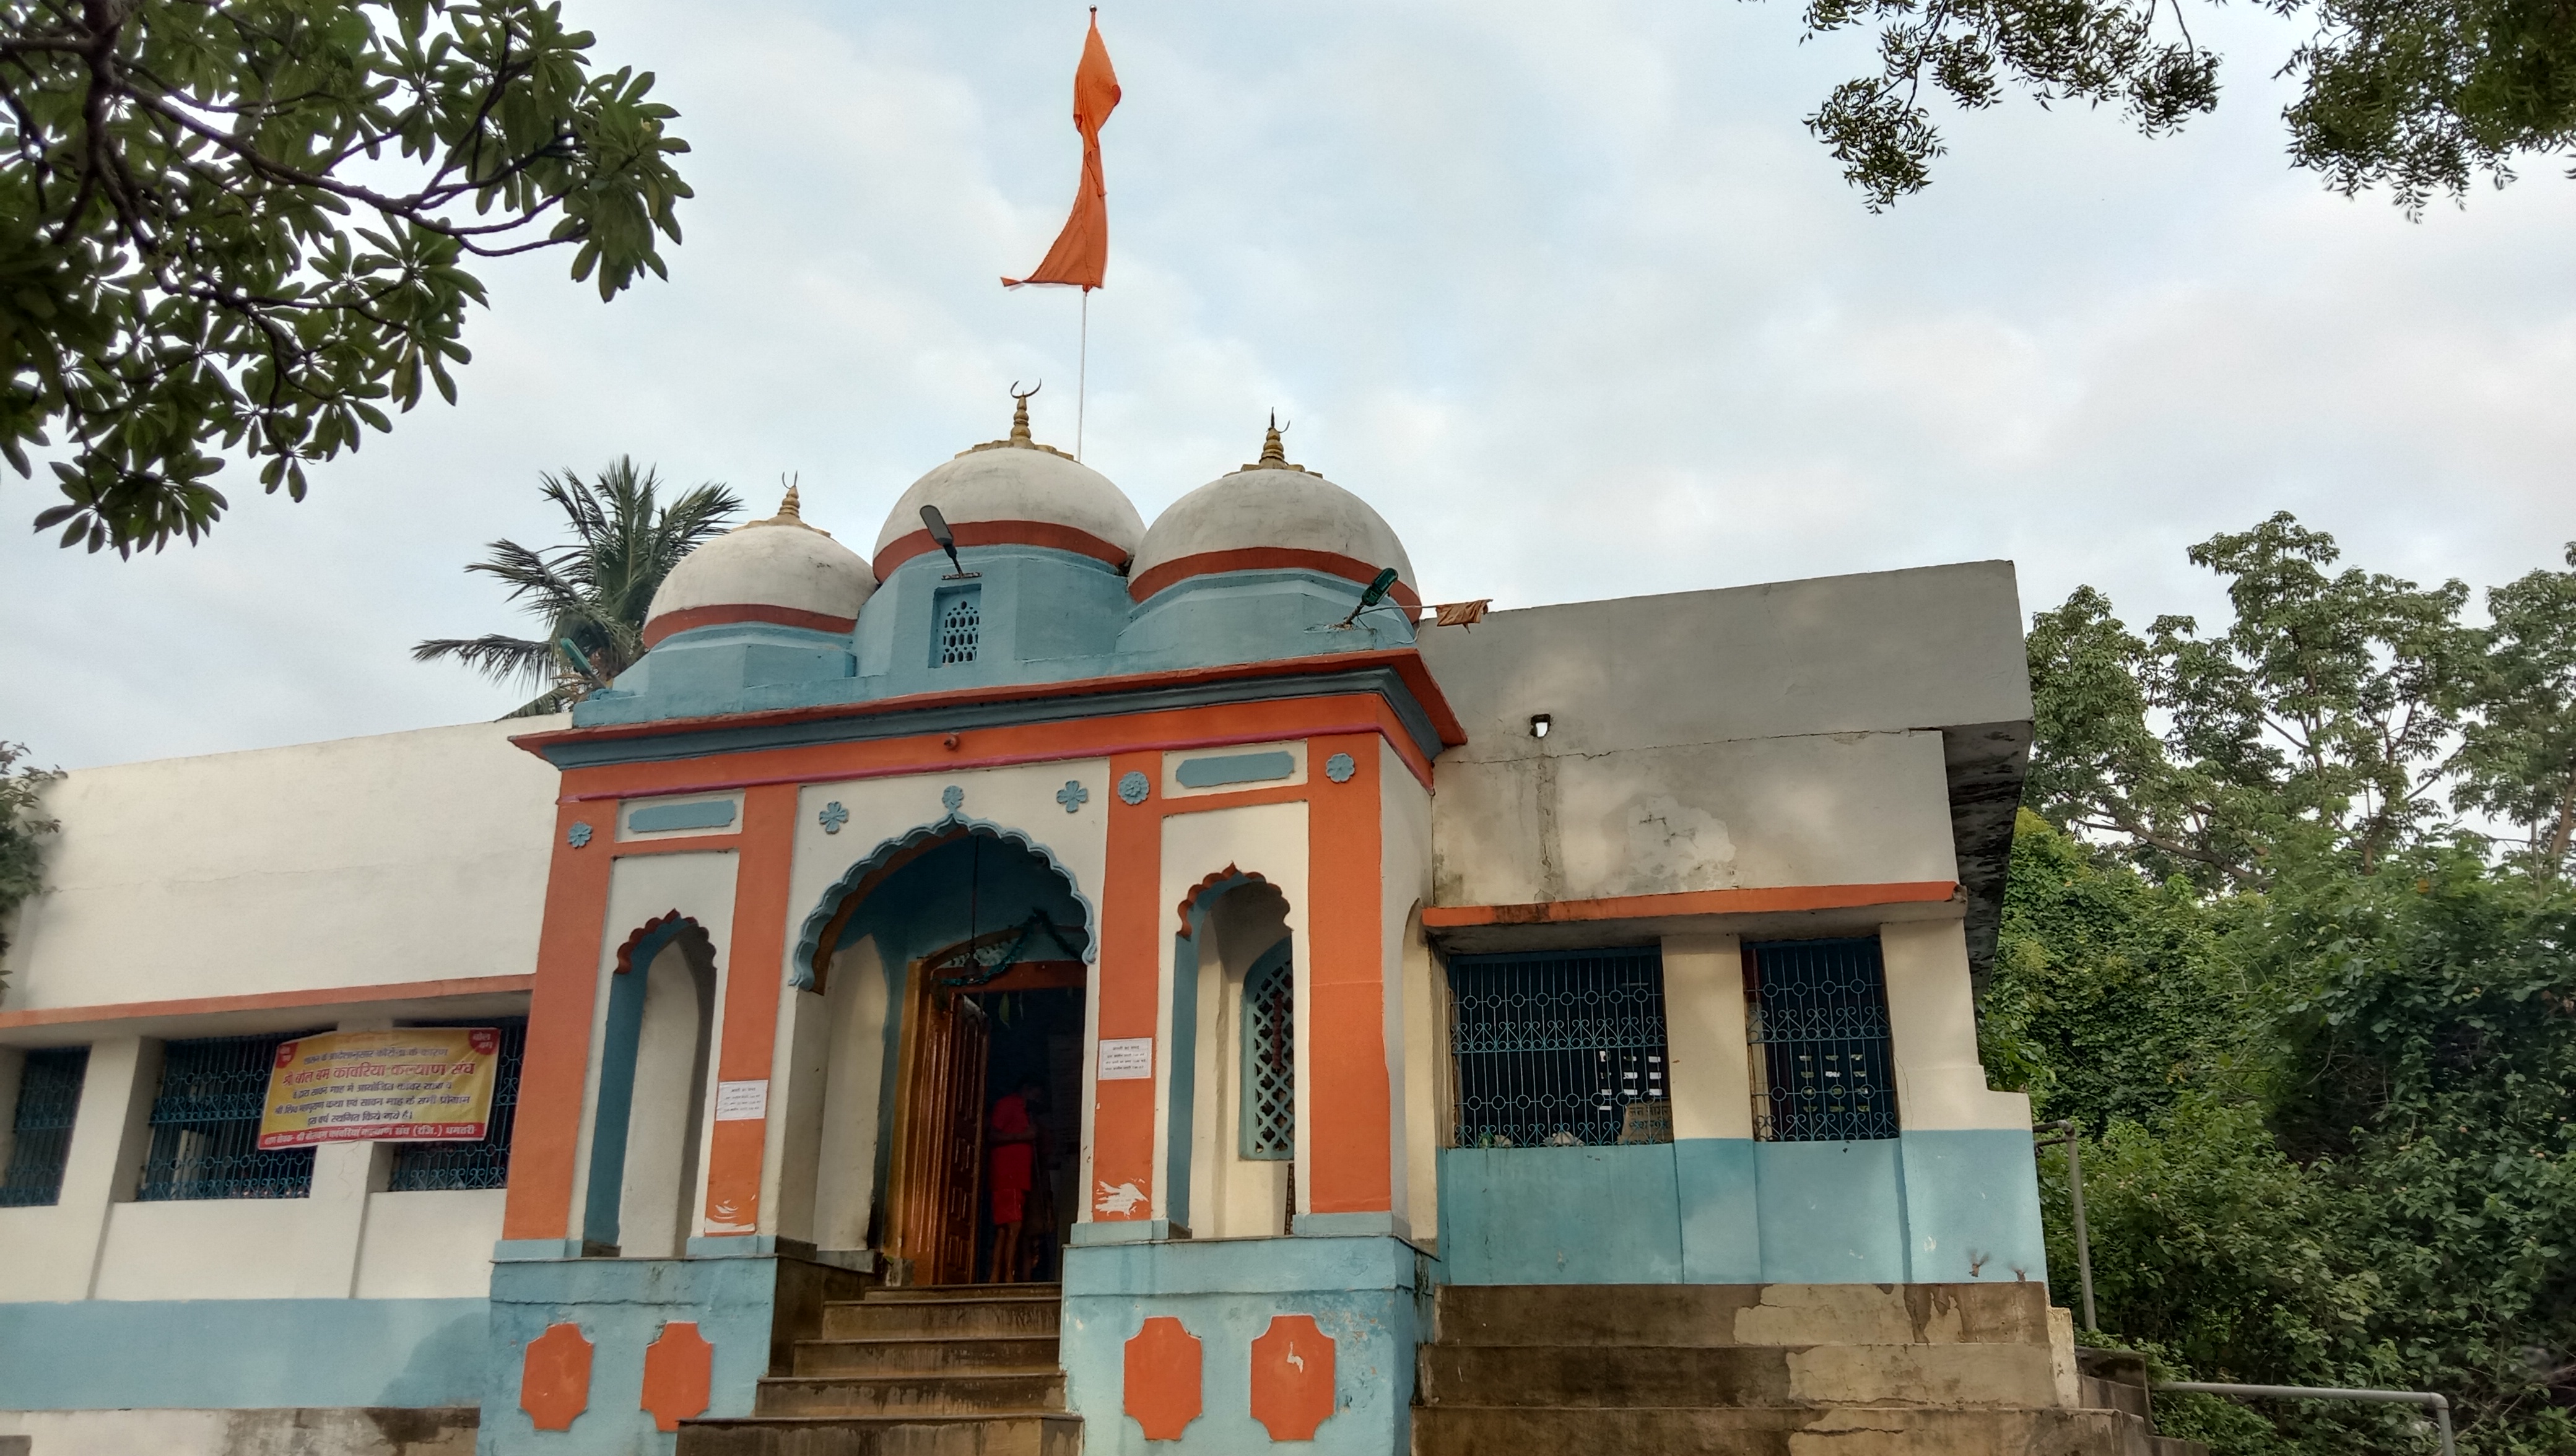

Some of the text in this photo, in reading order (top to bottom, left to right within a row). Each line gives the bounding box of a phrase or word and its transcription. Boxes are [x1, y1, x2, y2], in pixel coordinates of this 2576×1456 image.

[282, 1060, 476, 1086] श्री बोल बम कांवरिया कल्याण संघ
[357, 1081, 394, 1092] आयोजित
[326, 1099, 344, 1108] कथा
[346, 1098, 358, 1107] एवं
[361, 1098, 383, 1106] सावन
[386, 1098, 404, 1106] माह
[417, 1094, 437, 1104] सभी
[308, 1117, 317, 1125] इस
[318, 1113, 329, 1123] वर्ष
[331, 1112, 360, 1122] स्थगित
[362, 1111, 381, 1120] किये
[383, 1111, 400, 1120] गये
[412, 1125, 442, 1137] (रजि.)
